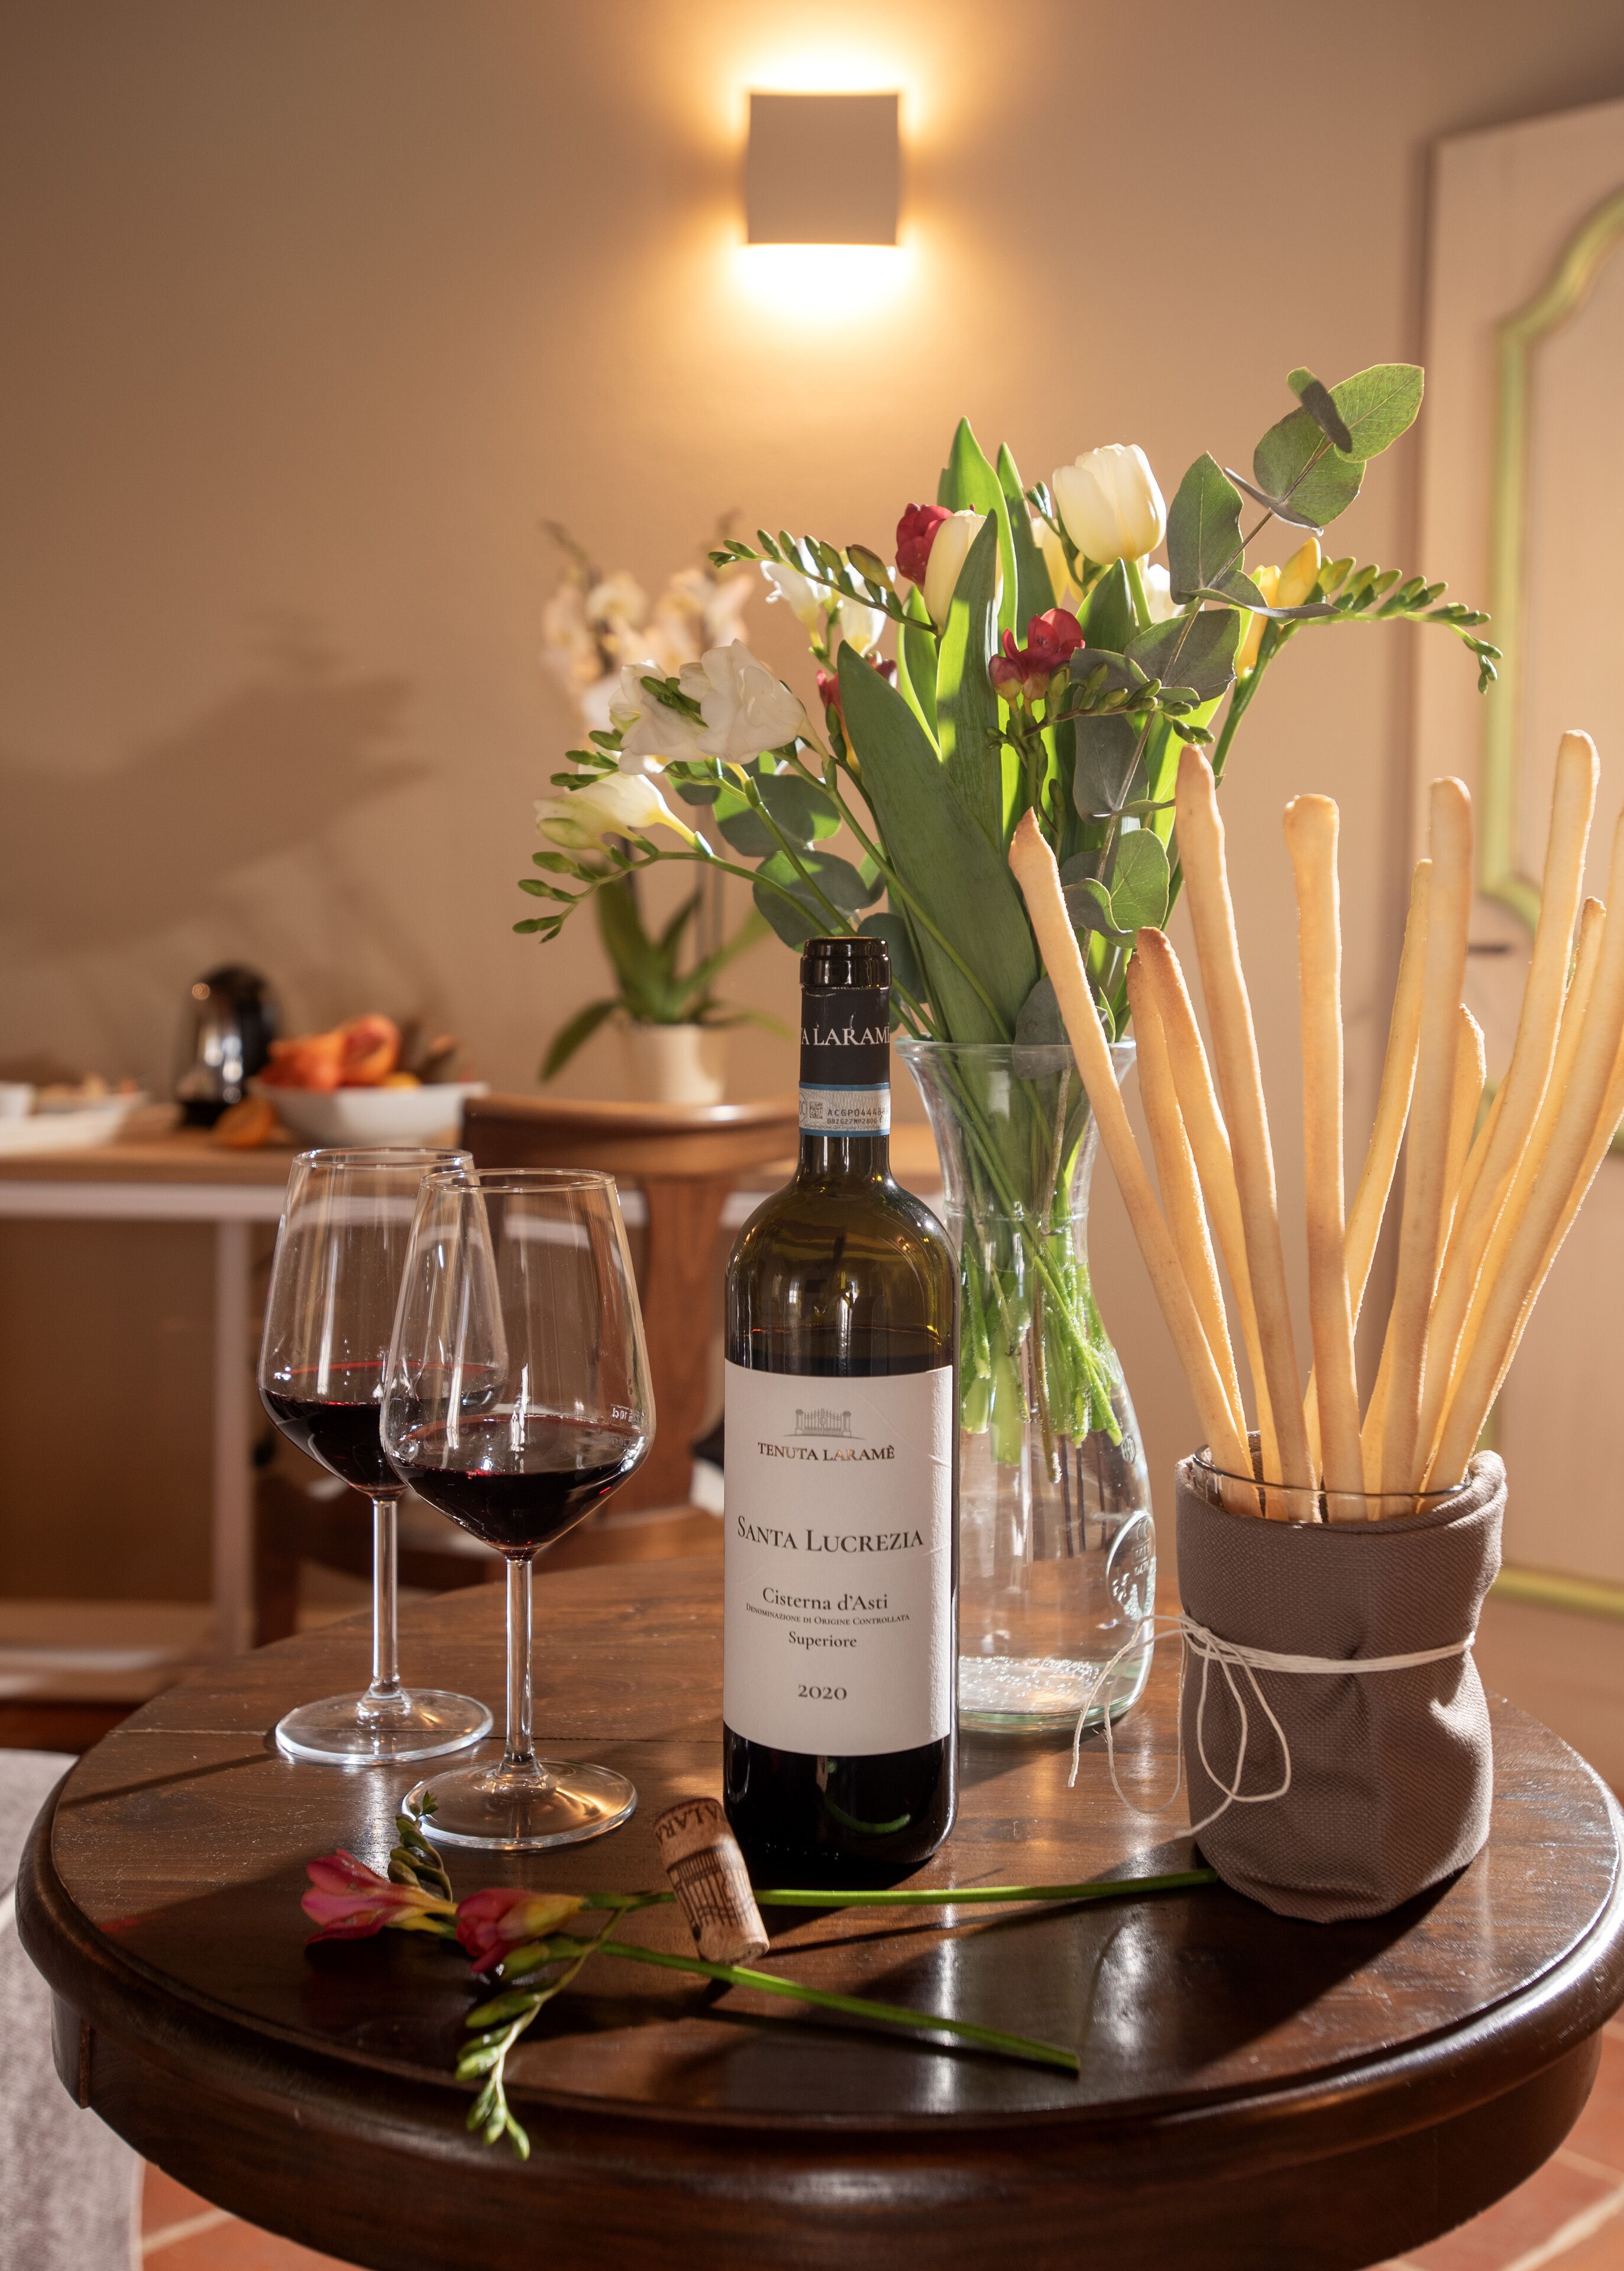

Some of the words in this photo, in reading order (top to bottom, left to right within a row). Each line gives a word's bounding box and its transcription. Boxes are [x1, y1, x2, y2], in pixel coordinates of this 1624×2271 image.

[758, 1442, 819, 1461] TENUTA
[823, 1445, 895, 1462] LARAMÈ
[737, 1515, 799, 1550] SANTA
[806, 1529, 924, 1553] LUCREZIA
[762, 1587, 832, 1610] Cisterna
[837, 1593, 888, 1611] d'Asti
[788, 1631, 857, 1650] Superiore
[798, 1684, 847, 1700] 2020
